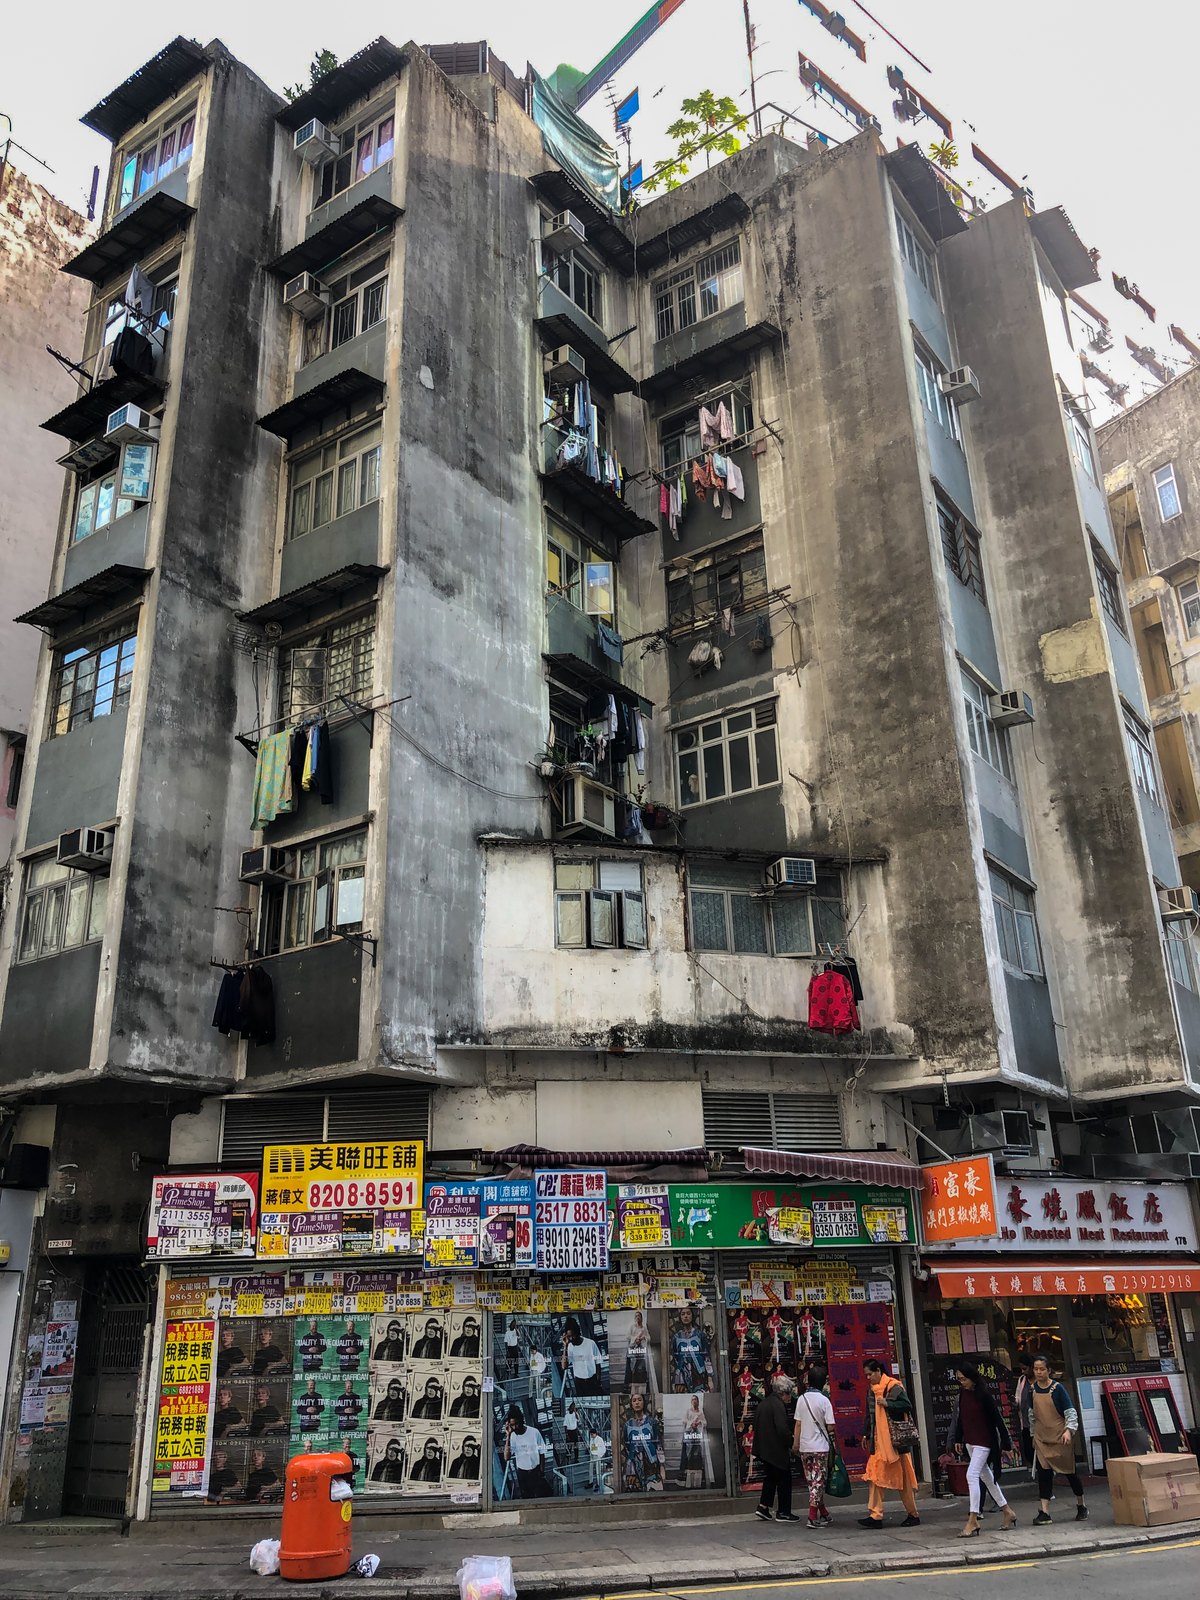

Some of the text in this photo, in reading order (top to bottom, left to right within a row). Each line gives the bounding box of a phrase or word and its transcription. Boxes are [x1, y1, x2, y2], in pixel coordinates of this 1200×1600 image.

[309, 1145, 418, 1171] 美聯旺舖
[560, 1174, 604, 1196] 康福物業
[943, 1167, 983, 1198] 富豪
[164, 1188, 206, 1208] PrimeShop
[429, 1197, 471, 1215] PrimeShop
[162, 1210, 210, 1221] 2111 3555
[536, 1202, 606, 1223] 2517 8831
[819, 1213, 837, 1223] 2517
[839, 1213, 857, 1222] 8831
[291, 1214, 334, 1233] PrimeShop
[429, 1218, 478, 1228] 2111 3555
[815, 1224, 853, 1236] 9350 0135
[181, 1229, 202, 1238] 2111
[292, 1236, 314, 1247] 2111
[318, 1235, 338, 1245] 3555
[537, 1228, 544, 1246] 租
[545, 1227, 597, 1248] 9010 2946
[1023, 1226, 1071, 1240] Roasted
[1077, 1227, 1105, 1241] Meat
[1110, 1228, 1169, 1243] Restaurant
[1175, 1236, 1187, 1245] 178
[545, 1247, 598, 1269] 9350 0135
[346, 1274, 388, 1292] PrimeShop
[1122, 1274, 1192, 1290] 23922918
[170, 1293, 192, 1301] 9865
[172, 1323, 208, 1331] TML
[166, 1342, 212, 1361] 稅務申報
[163, 1363, 211, 1383] 成立公司
[167, 1396, 203, 1405] TML
[160, 1415, 207, 1436] 稅務申報
[157, 1438, 205, 1458] 成立公司
